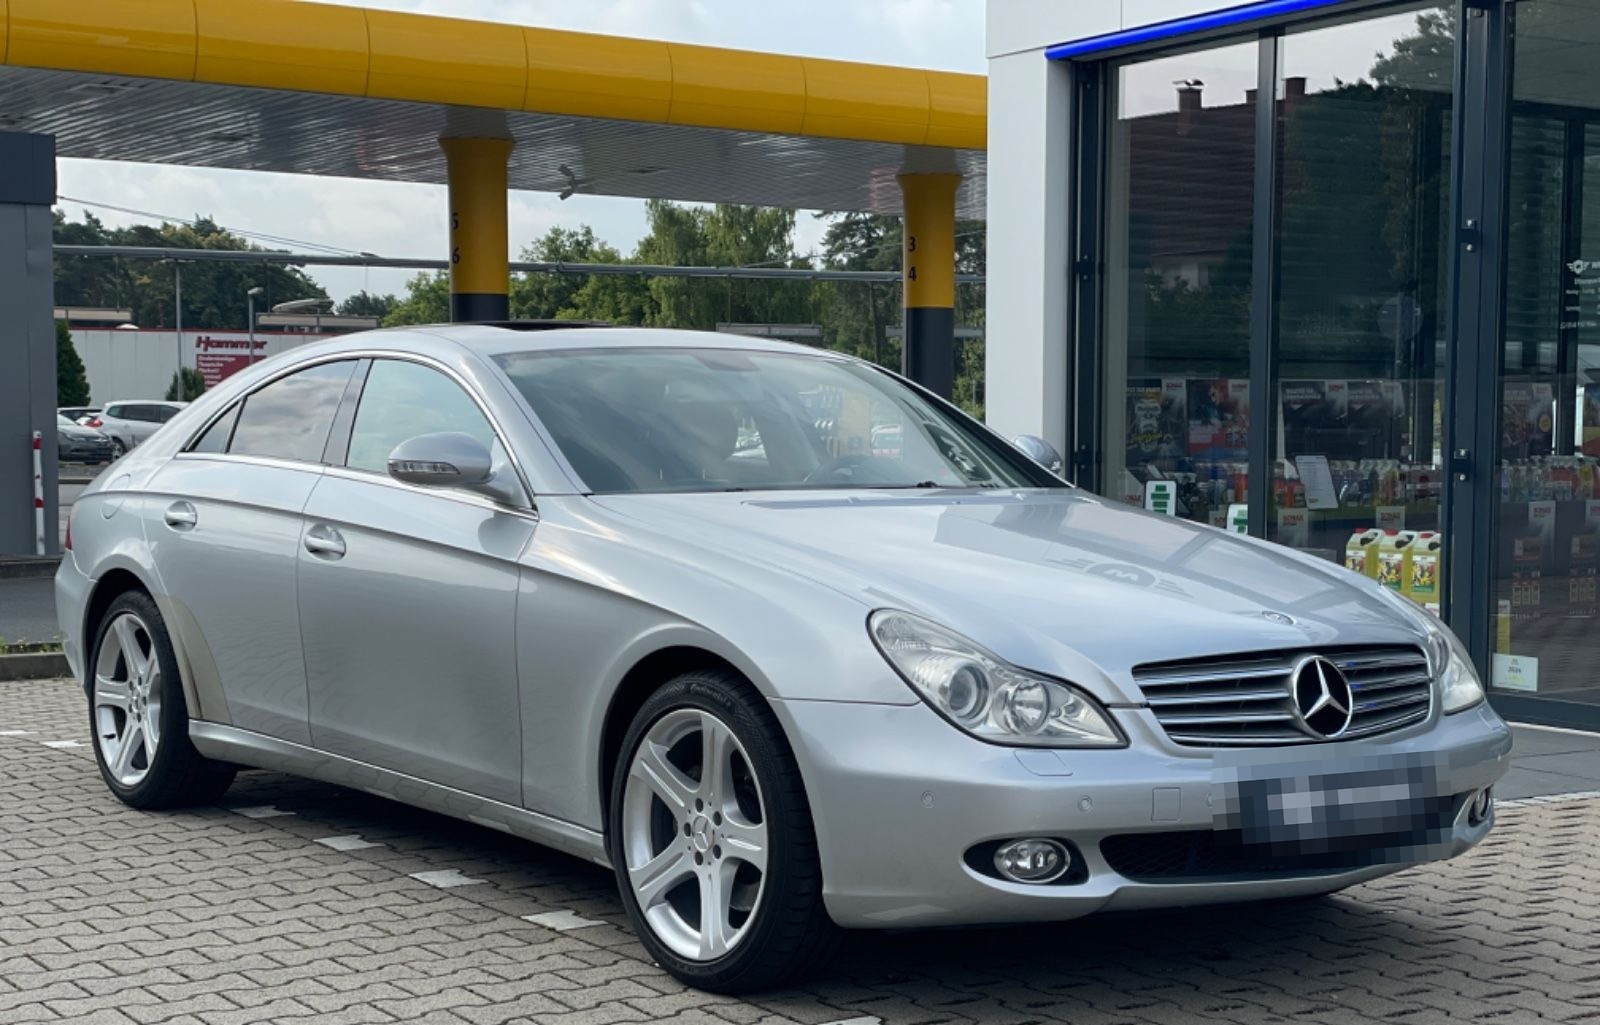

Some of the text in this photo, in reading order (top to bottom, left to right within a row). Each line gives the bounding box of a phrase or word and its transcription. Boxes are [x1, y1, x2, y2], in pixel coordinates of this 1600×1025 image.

[908, 236, 916, 252] 3
[452, 247, 460, 264] 6
[908, 266, 917, 281] 4
